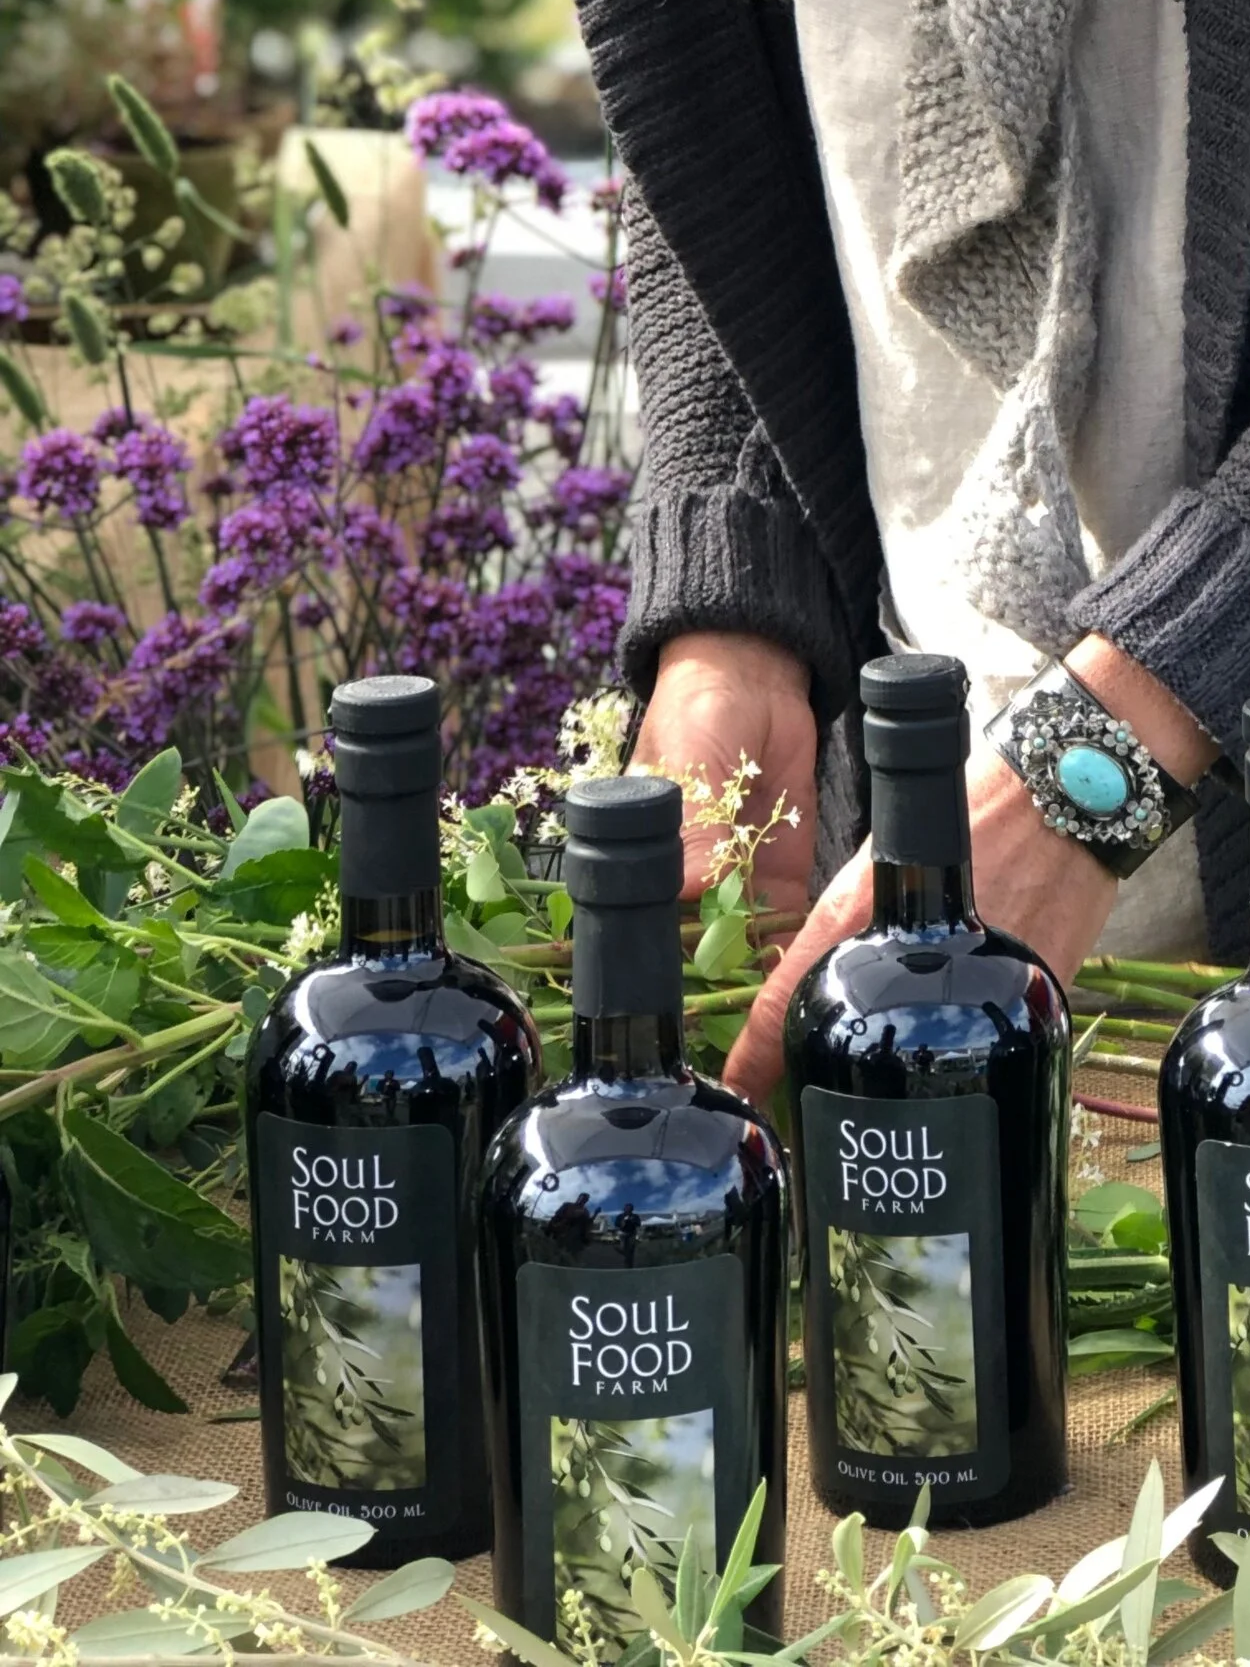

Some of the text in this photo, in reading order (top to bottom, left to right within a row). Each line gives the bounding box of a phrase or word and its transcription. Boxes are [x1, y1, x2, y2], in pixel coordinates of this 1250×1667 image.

[841, 1161, 947, 1201] FOOD
[292, 1189, 399, 1229] FOOD
[861, 1198, 925, 1214] FARM
[312, 1226, 375, 1244] FARM
[570, 1340, 692, 1386] FOOD
[596, 1377, 668, 1395] FARM
[837, 1460, 978, 1486] OLIVE OIL 500 ML
[328, 1502, 355, 1518] OIL
[360, 1505, 397, 1519] 500
[403, 1503, 426, 1518] ML
